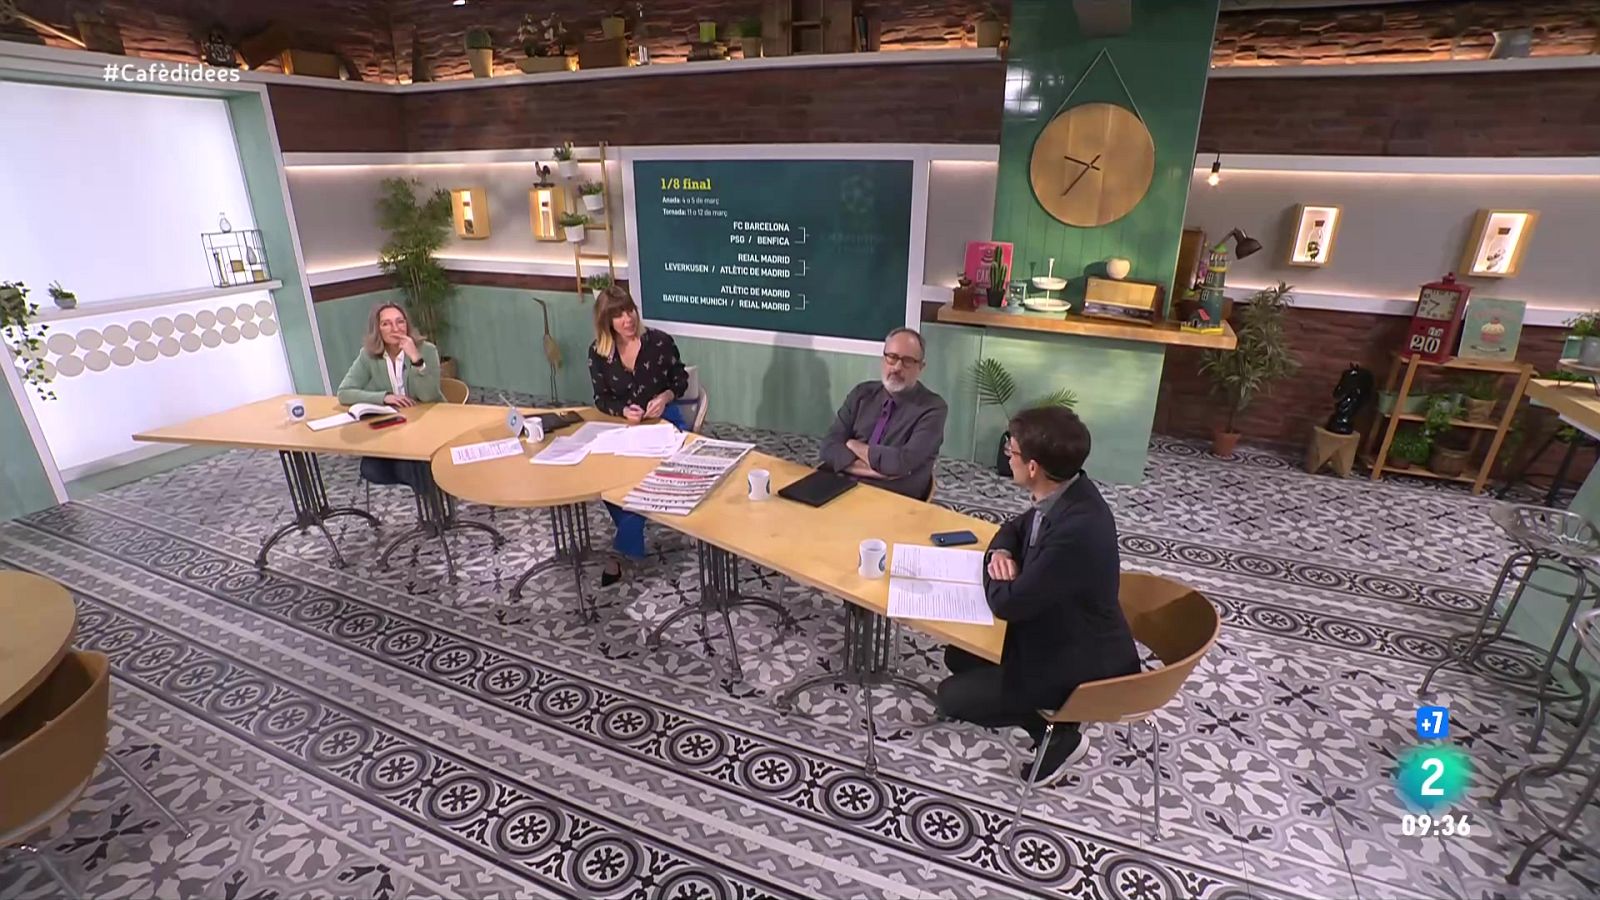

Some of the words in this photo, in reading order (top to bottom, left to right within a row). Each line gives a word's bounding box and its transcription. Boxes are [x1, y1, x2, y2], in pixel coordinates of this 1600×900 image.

[661, 178, 680, 190] 1/8
[683, 178, 711, 190] final
[704, 198, 720, 206] març
[663, 208, 686, 216] Tornada:
[687, 208, 692, 216] 11
[712, 210, 728, 218] març
[733, 221, 743, 230] FC
[744, 221, 790, 232] BARCELONA
[730, 234, 745, 244] PSG
[757, 235, 790, 246] BENFICA
[738, 253, 760, 263] REIAL
[760, 255, 790, 264] MADRID
[664, 262, 709, 273] LEVERKUSEN
[749, 266, 760, 276] DE
[760, 268, 790, 278] MADRID
[749, 287, 760, 296] DE
[760, 288, 790, 298] MADRID
[662, 294, 689, 303] BAYERN
[689, 296, 700, 304] DE
[700, 297, 728, 306] MUNICH
[739, 299, 760, 309] REIAL
[760, 301, 790, 311] MADRID
[1411, 335, 1440, 353] 20
